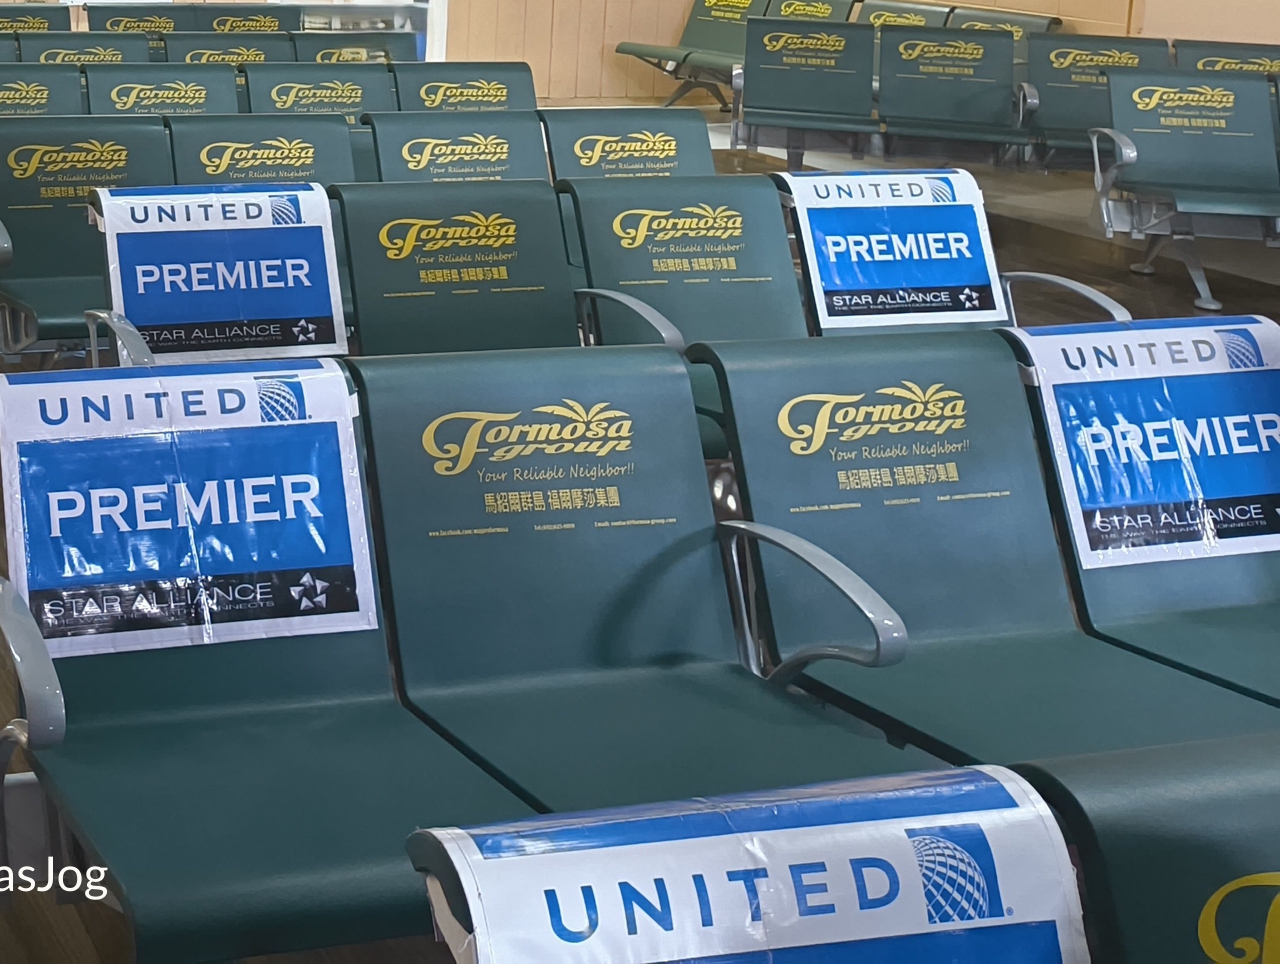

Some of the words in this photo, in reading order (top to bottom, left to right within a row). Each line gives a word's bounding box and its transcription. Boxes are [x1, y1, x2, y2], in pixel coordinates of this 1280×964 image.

[110, 83, 207, 110] Formosa
[270, 82, 363, 109] Formosa
[420, 80, 508, 108] Formosa
[7, 141, 129, 179] Formosa
[199, 145, 315, 176] Formosa
[401, 137, 510, 170] Formosa
[573, 134, 677, 166] Formosa
[813, 182, 925, 200] UNITED
[129, 201, 263, 225] UNITED
[378, 220, 517, 259] Formosa
[421, 237, 516, 251] group
[612, 210, 743, 248] Formosa
[654, 230, 742, 241] group
[438, 251, 472, 264] Reliable
[670, 242, 702, 253] Reliable
[823, 231, 973, 263] PREMIER
[134, 258, 312, 294] PREMIER
[832, 294, 873, 306] STAR
[876, 291, 951, 304] ALLIANCE
[140, 329, 185, 342] STAR
[191, 324, 282, 340] ALLIANCE
[1060, 339, 1217, 371] UNITED
[37, 387, 247, 426] UNITED
[777, 390, 967, 455] Formosa
[839, 416, 967, 441] group
[422, 409, 635, 476] Formosa
[488, 439, 632, 462] group
[829, 445, 858, 462] Your
[862, 442, 908, 459] Reliable
[912, 439, 970, 457] Neighbor!!
[1082, 413, 1280, 467] PREMIER
[476, 467, 508, 484] Your
[513, 464, 566, 481] Reliable
[569, 462, 635, 480] Neighbor!!
[46, 473, 324, 538] PREMIER
[1097, 514, 1153, 533] STAR
[1160, 504, 1265, 526] ALLIANCE
[46, 595, 122, 618] STAR
[131, 582, 274, 611] ALLIANCE
[542, 855, 901, 944] UNITED
